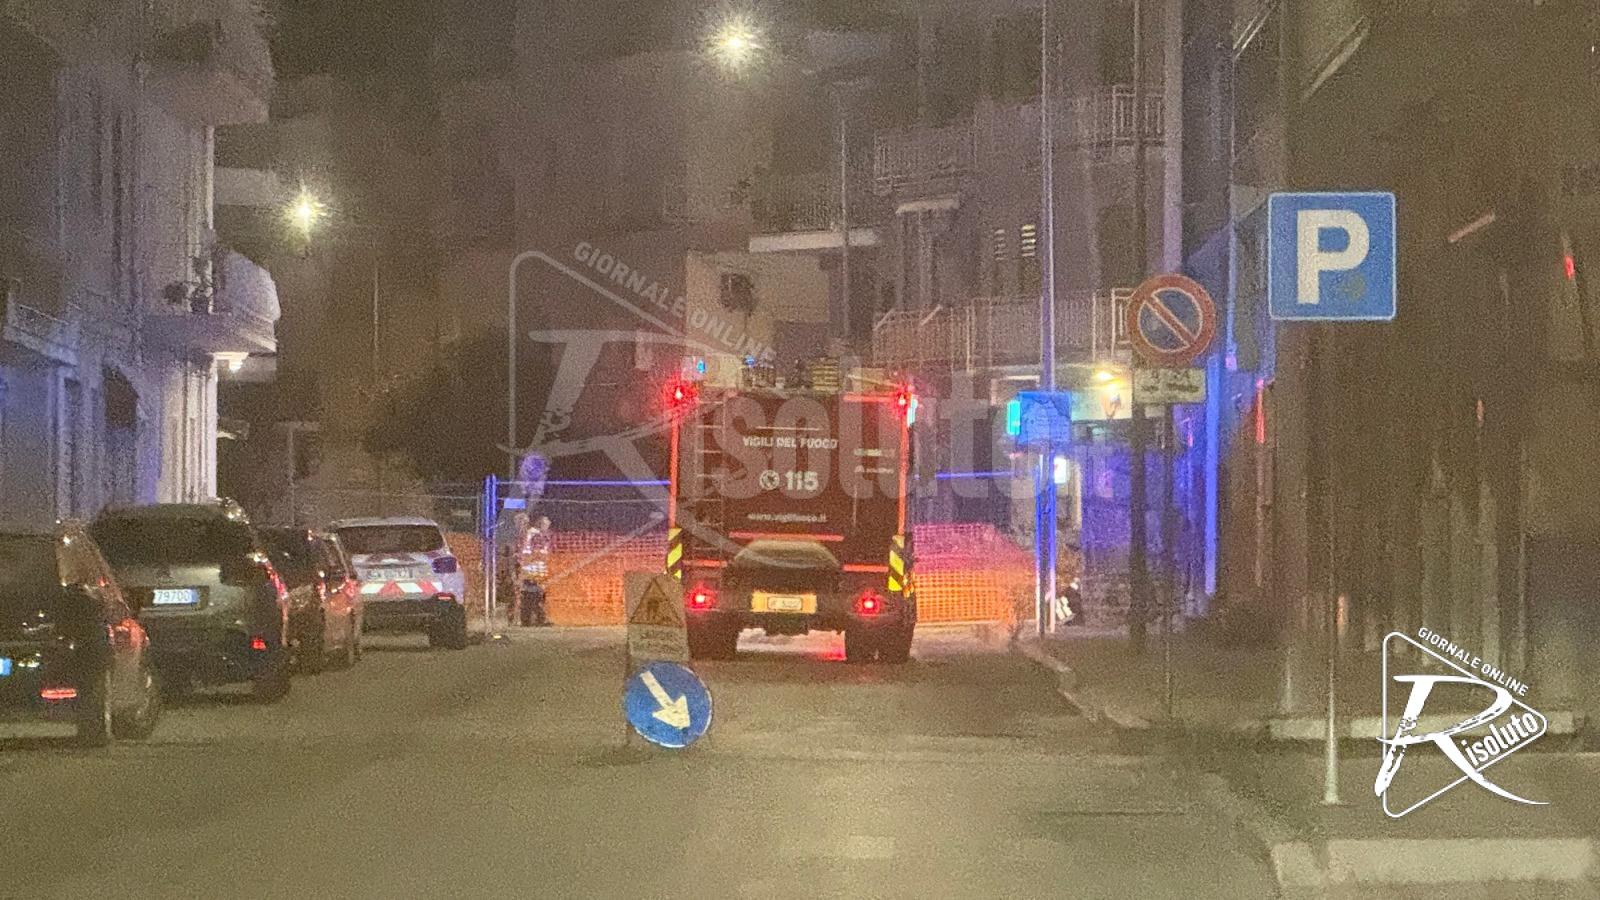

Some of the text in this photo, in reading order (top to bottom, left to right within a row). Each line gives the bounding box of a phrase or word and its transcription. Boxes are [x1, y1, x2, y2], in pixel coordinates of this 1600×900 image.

[1297, 209, 1370, 304] P
[743, 436, 839, 450] VIGILI DEL FUOCO
[785, 470, 819, 491] 115
